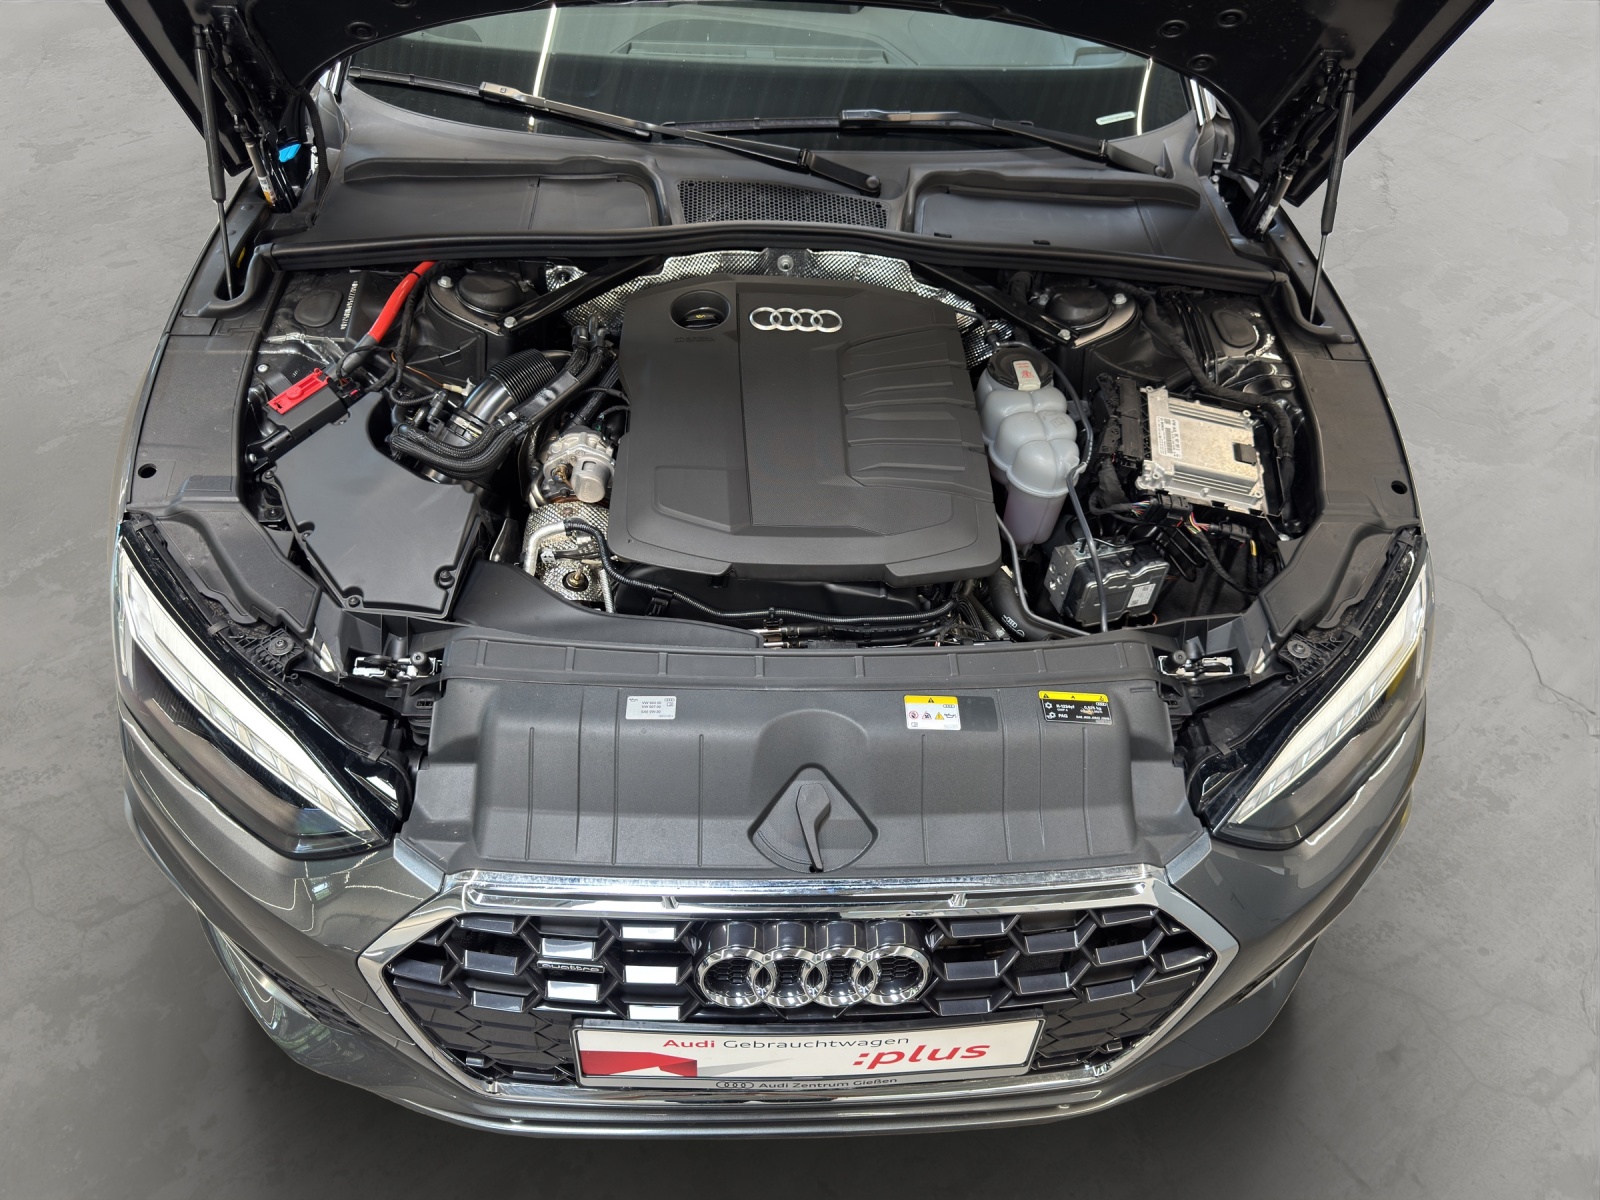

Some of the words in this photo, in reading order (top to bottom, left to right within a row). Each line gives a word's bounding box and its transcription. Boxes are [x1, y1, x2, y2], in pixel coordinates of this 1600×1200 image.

[542, 963, 600, 972] quattro
[663, 1039, 715, 1048] Audi
[723, 1037, 909, 1049] Gebrauchtwagen
[792, 1081, 849, 1089] Zentrum
[853, 1078, 898, 1087] Gießen
